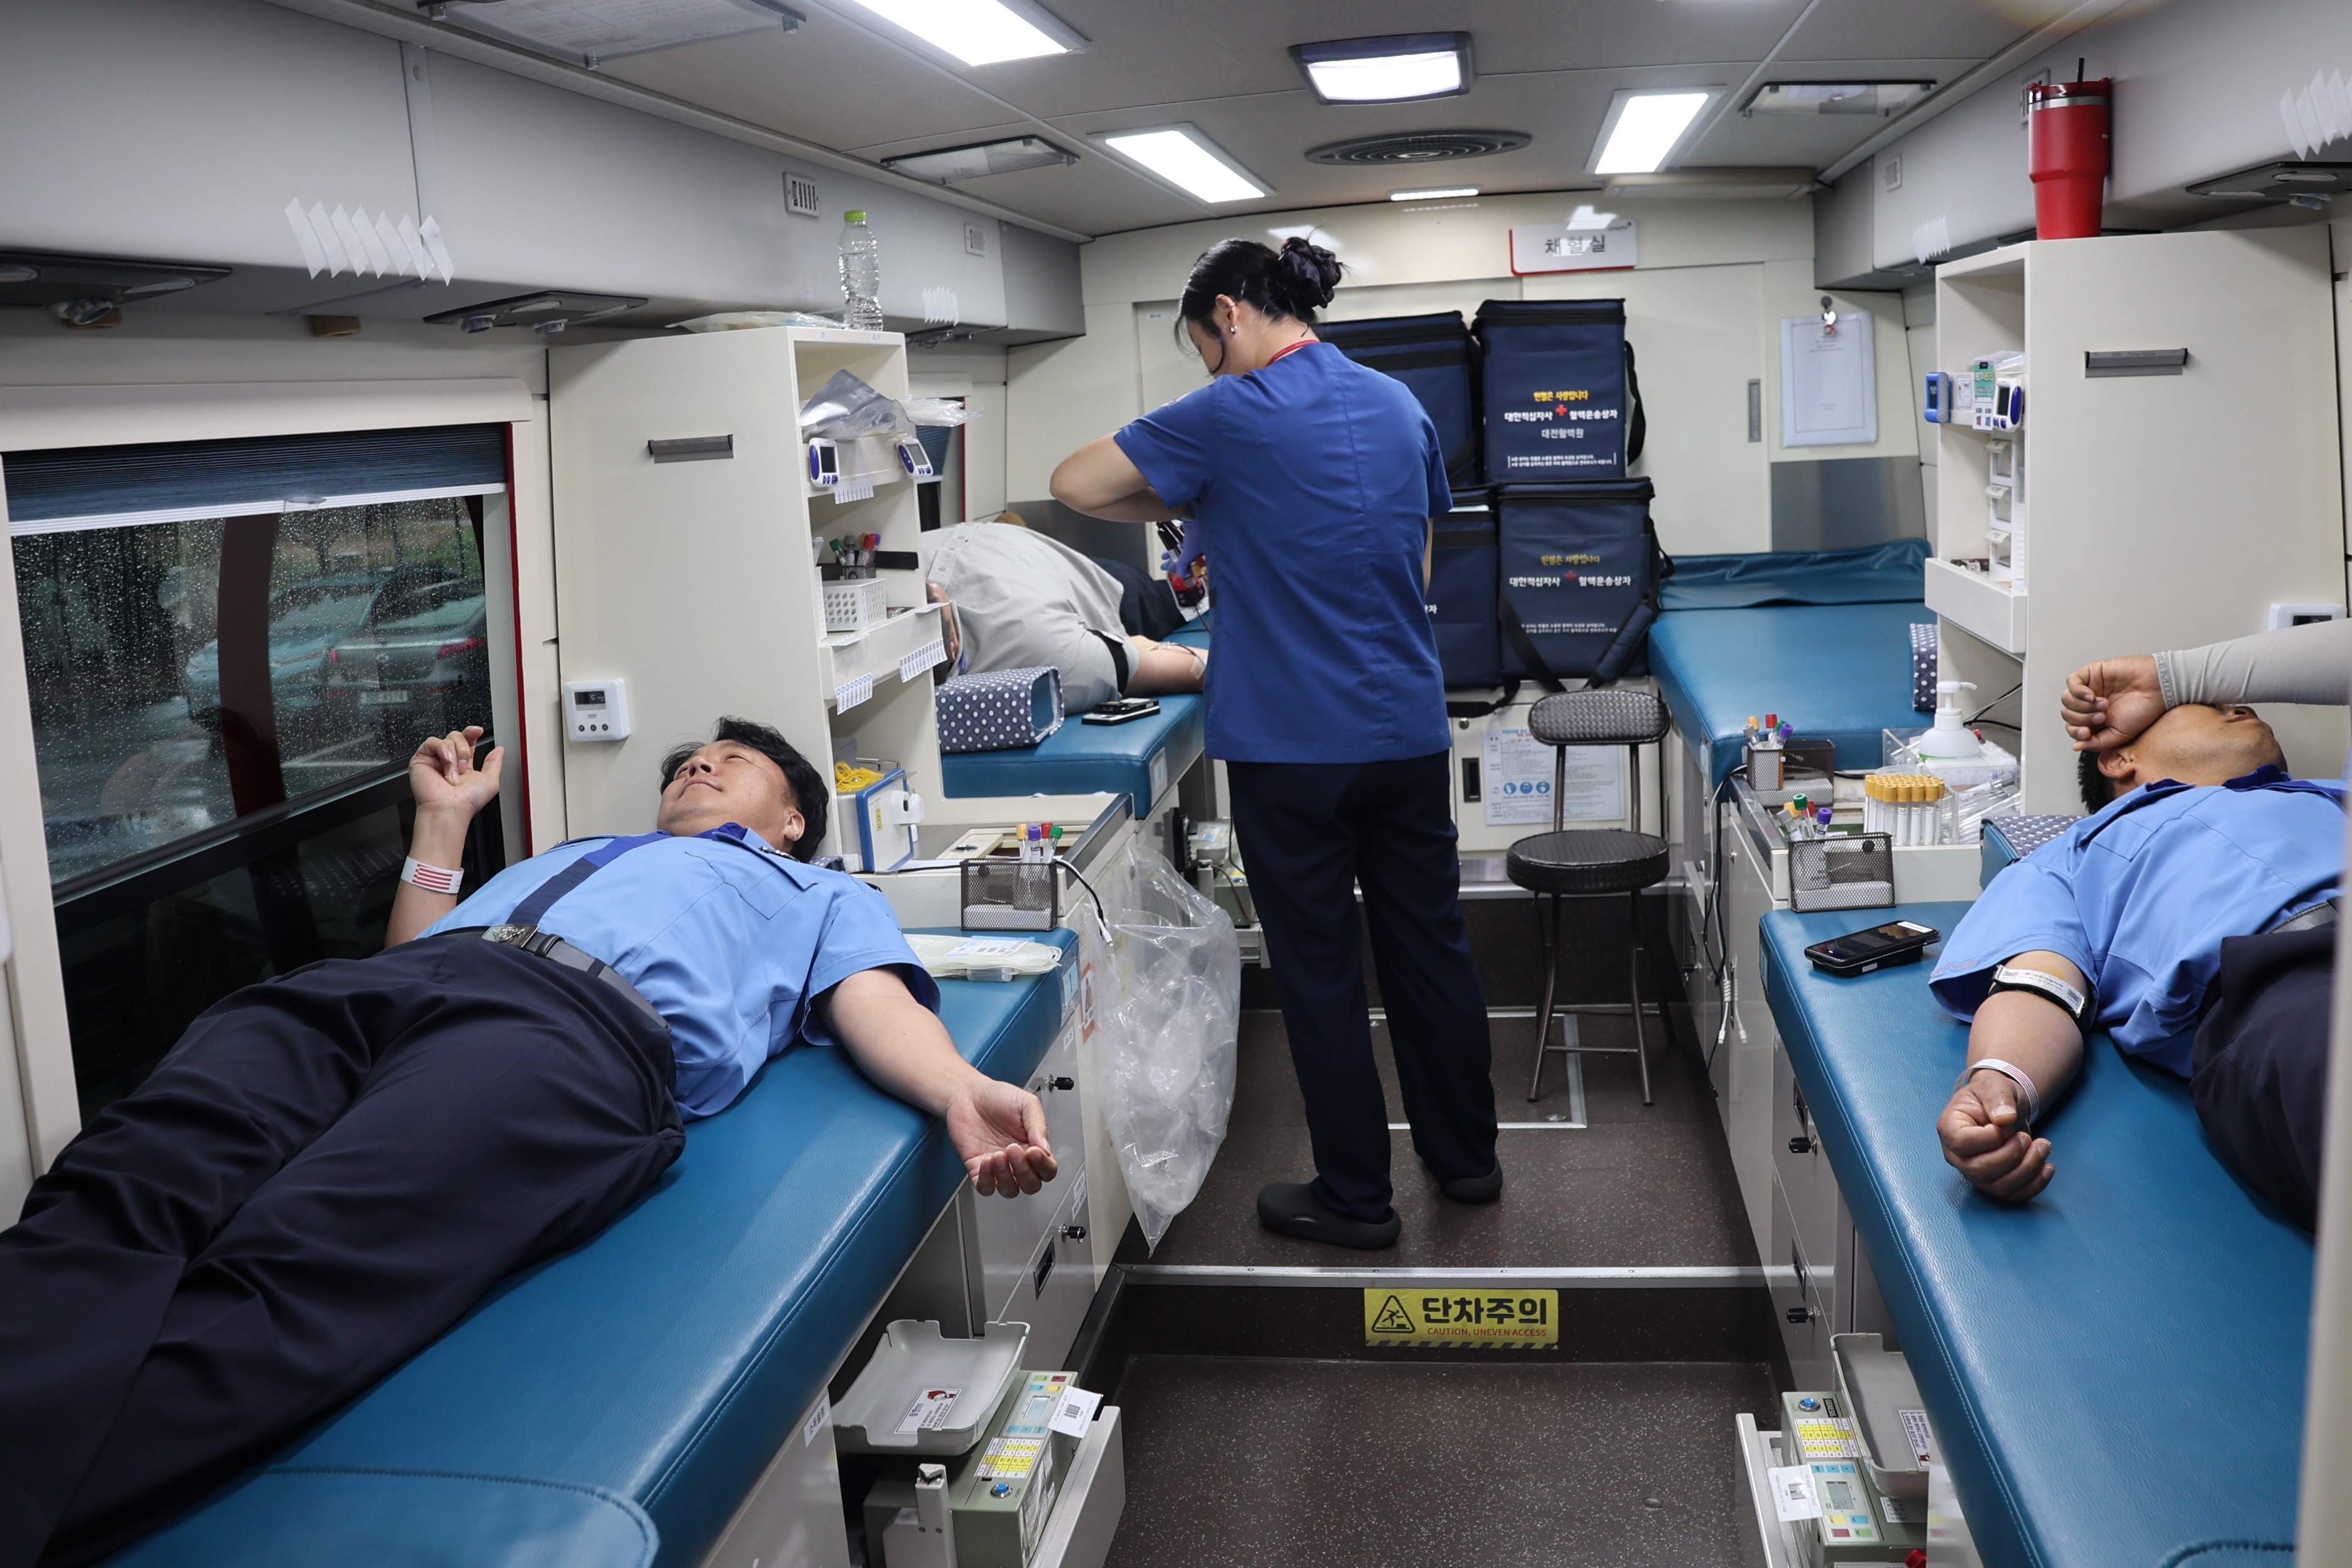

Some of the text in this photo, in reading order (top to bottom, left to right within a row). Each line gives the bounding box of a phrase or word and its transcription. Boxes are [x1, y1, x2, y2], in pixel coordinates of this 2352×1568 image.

[1545, 234, 1606, 254] 채혈실
[1533, 390, 1589, 401] 헌혈은 사랑입니다
[1505, 410, 1618, 422] 대한적십자사 혈액운송상자
[1542, 428, 1584, 438] 대전혈액원
[1510, 575, 1631, 587] 대한적십자사 혈액운송상자
[1422, 1297, 1547, 1325] 단차주의
[1427, 1327, 1471, 1337] CAUTION,
[1512, 1329, 1547, 1337] ACCESS
